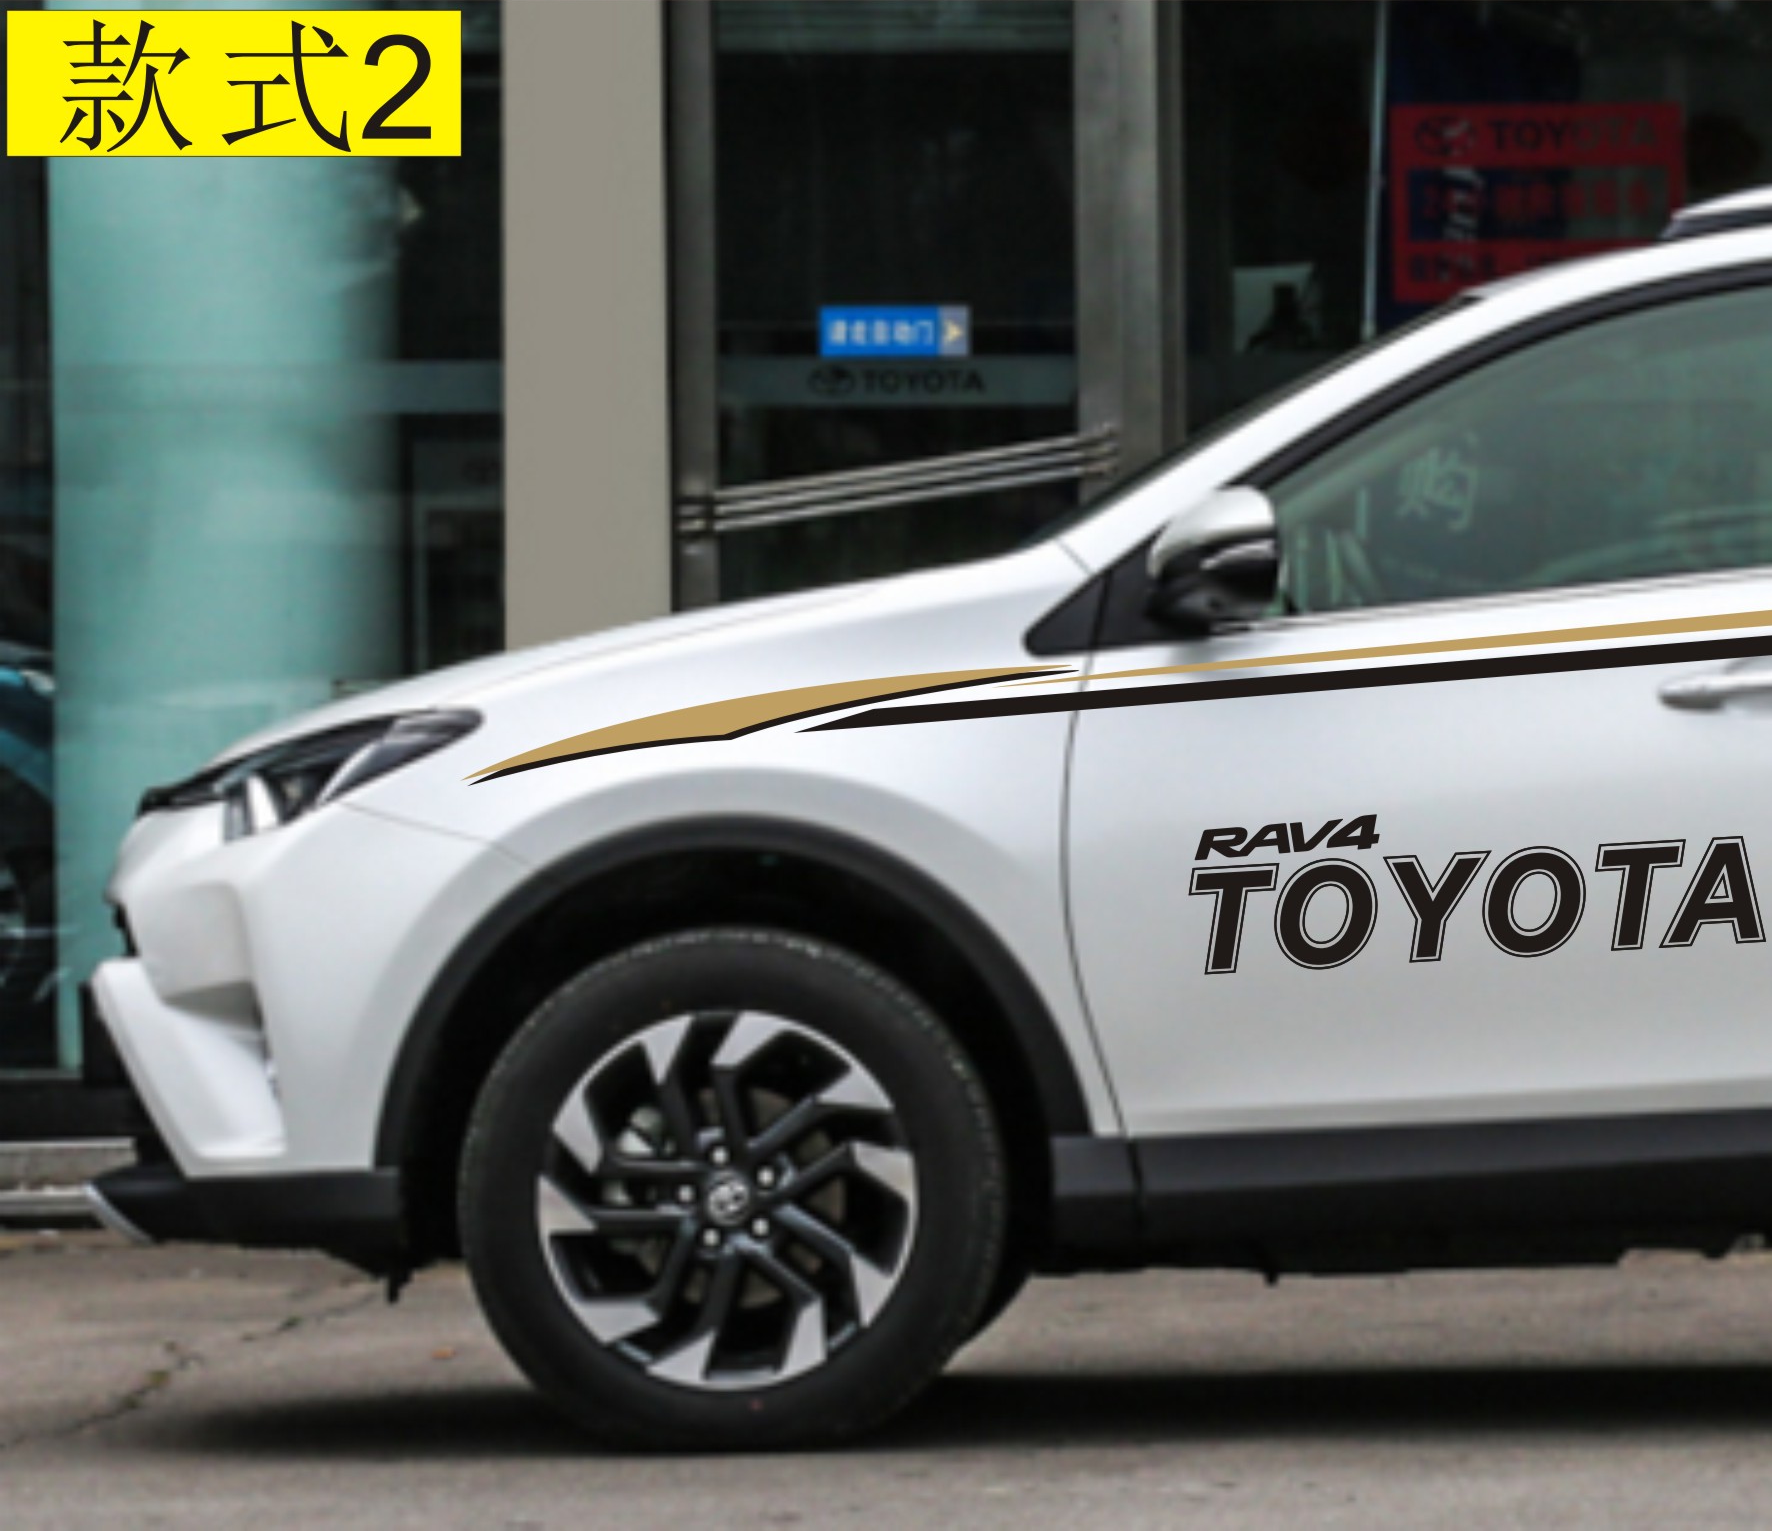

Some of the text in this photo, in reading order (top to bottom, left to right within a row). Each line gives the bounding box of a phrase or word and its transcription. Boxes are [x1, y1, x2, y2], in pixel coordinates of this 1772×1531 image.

[1486, 118, 1657, 151] TOYOTA
[862, 368, 985, 395] TOYOTA
[1194, 813, 1381, 861] RAV4
[1188, 835, 1767, 976] TOYOTA
